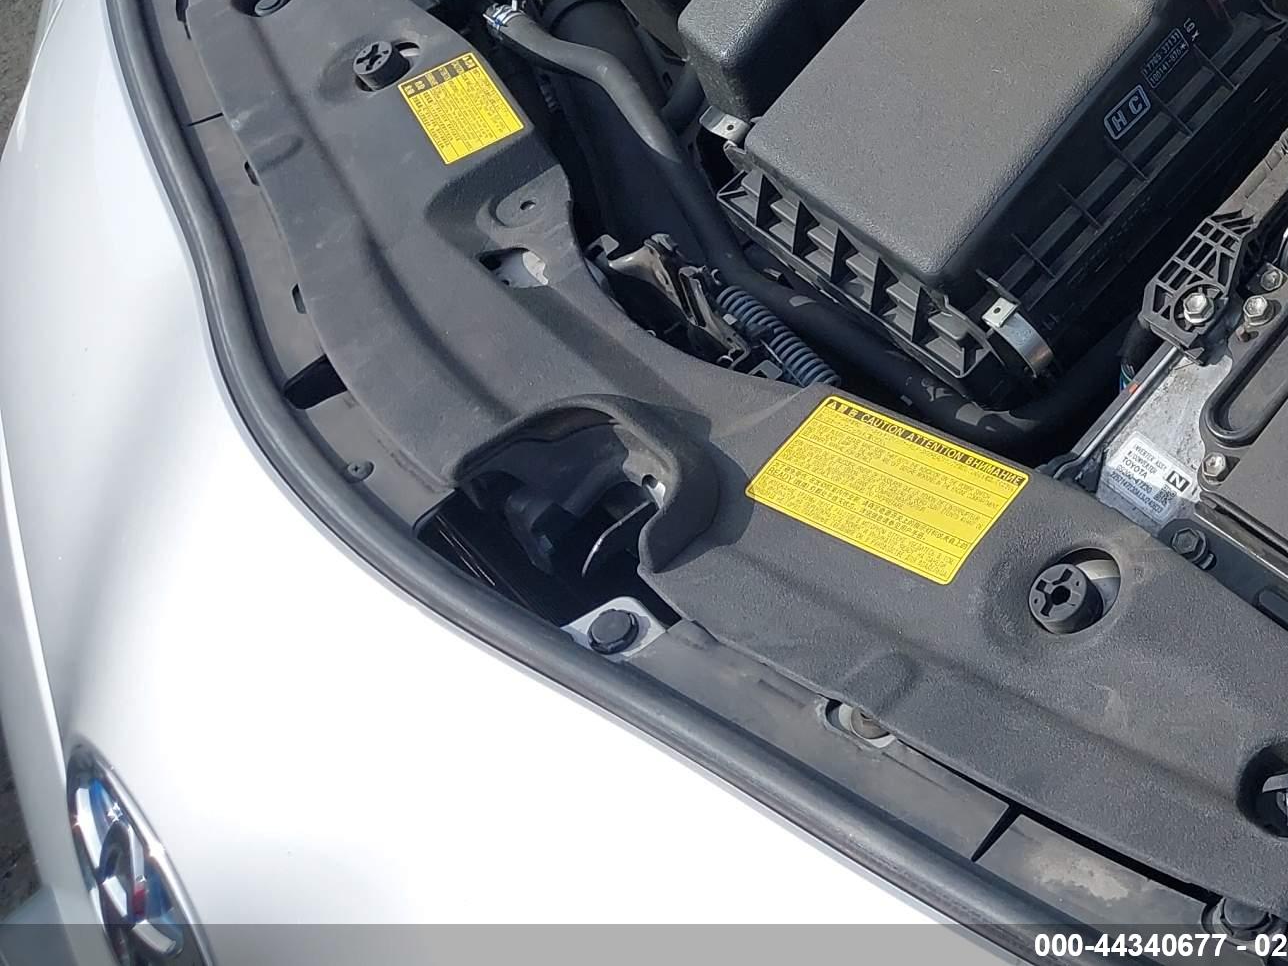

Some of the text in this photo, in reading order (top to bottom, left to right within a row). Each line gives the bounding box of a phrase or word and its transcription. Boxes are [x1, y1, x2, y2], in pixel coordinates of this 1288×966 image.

[861, 413, 1023, 485] CAUTION ATTENTION ВНИМАНИЕ
[1121, 457, 1148, 479] TOYOTA
